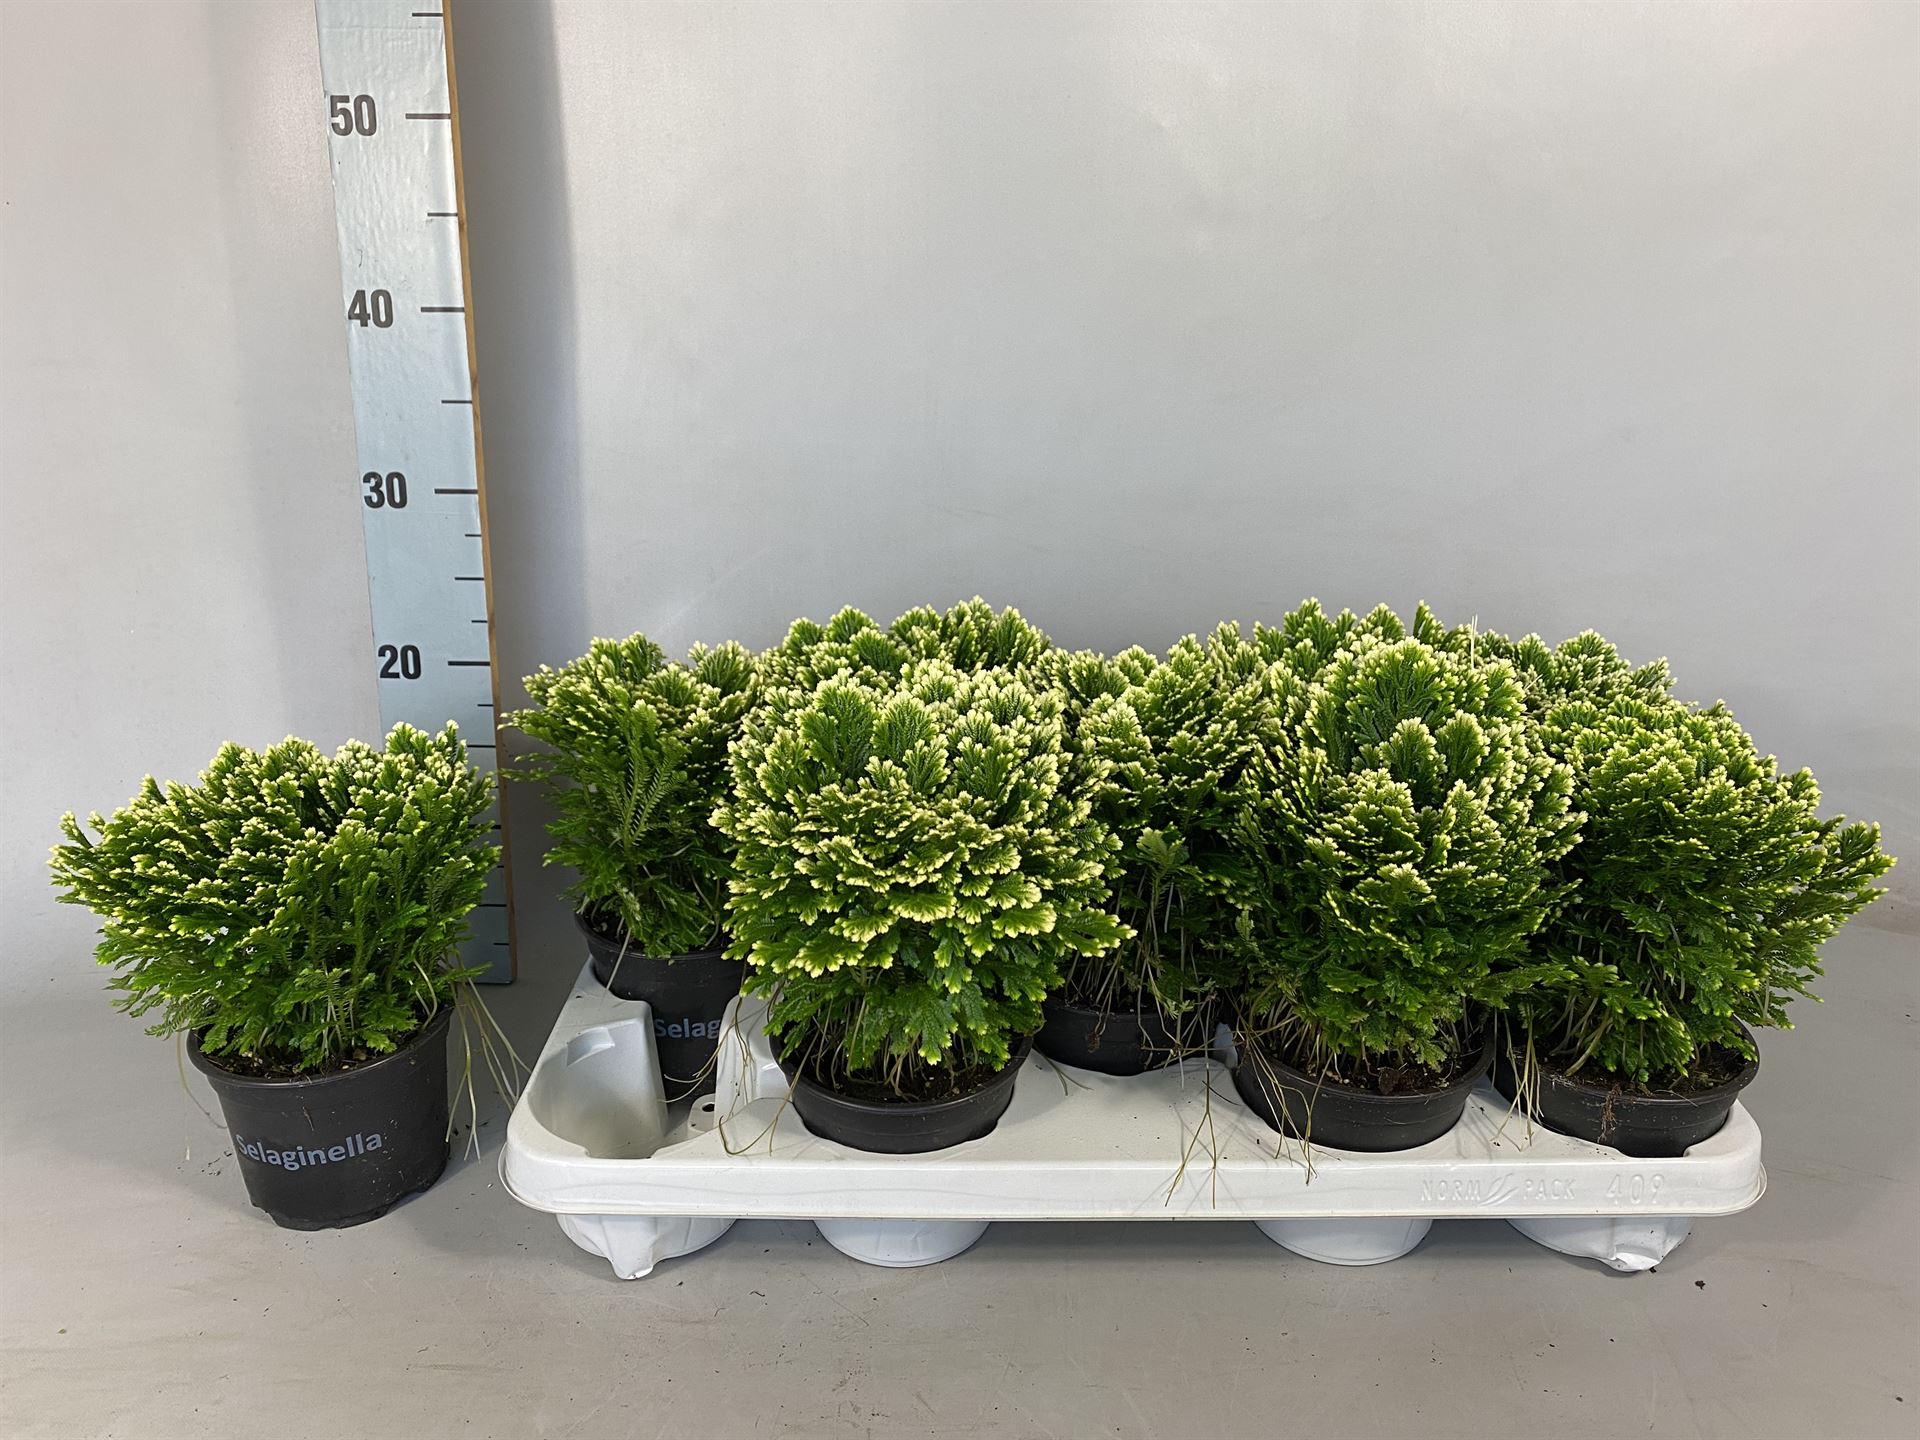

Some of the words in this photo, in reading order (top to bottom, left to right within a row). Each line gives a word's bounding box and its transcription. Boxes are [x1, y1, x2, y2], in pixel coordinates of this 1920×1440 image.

[330, 94, 377, 137] 50
[347, 289, 394, 328] 40
[362, 471, 408, 509] 30
[377, 644, 422, 680] 20
[234, 1133, 383, 1171] Selaginella
[1421, 1179, 1481, 1201] NORM
[1523, 1178, 1576, 1200] PACK
[1605, 1173, 1665, 1205] 409
